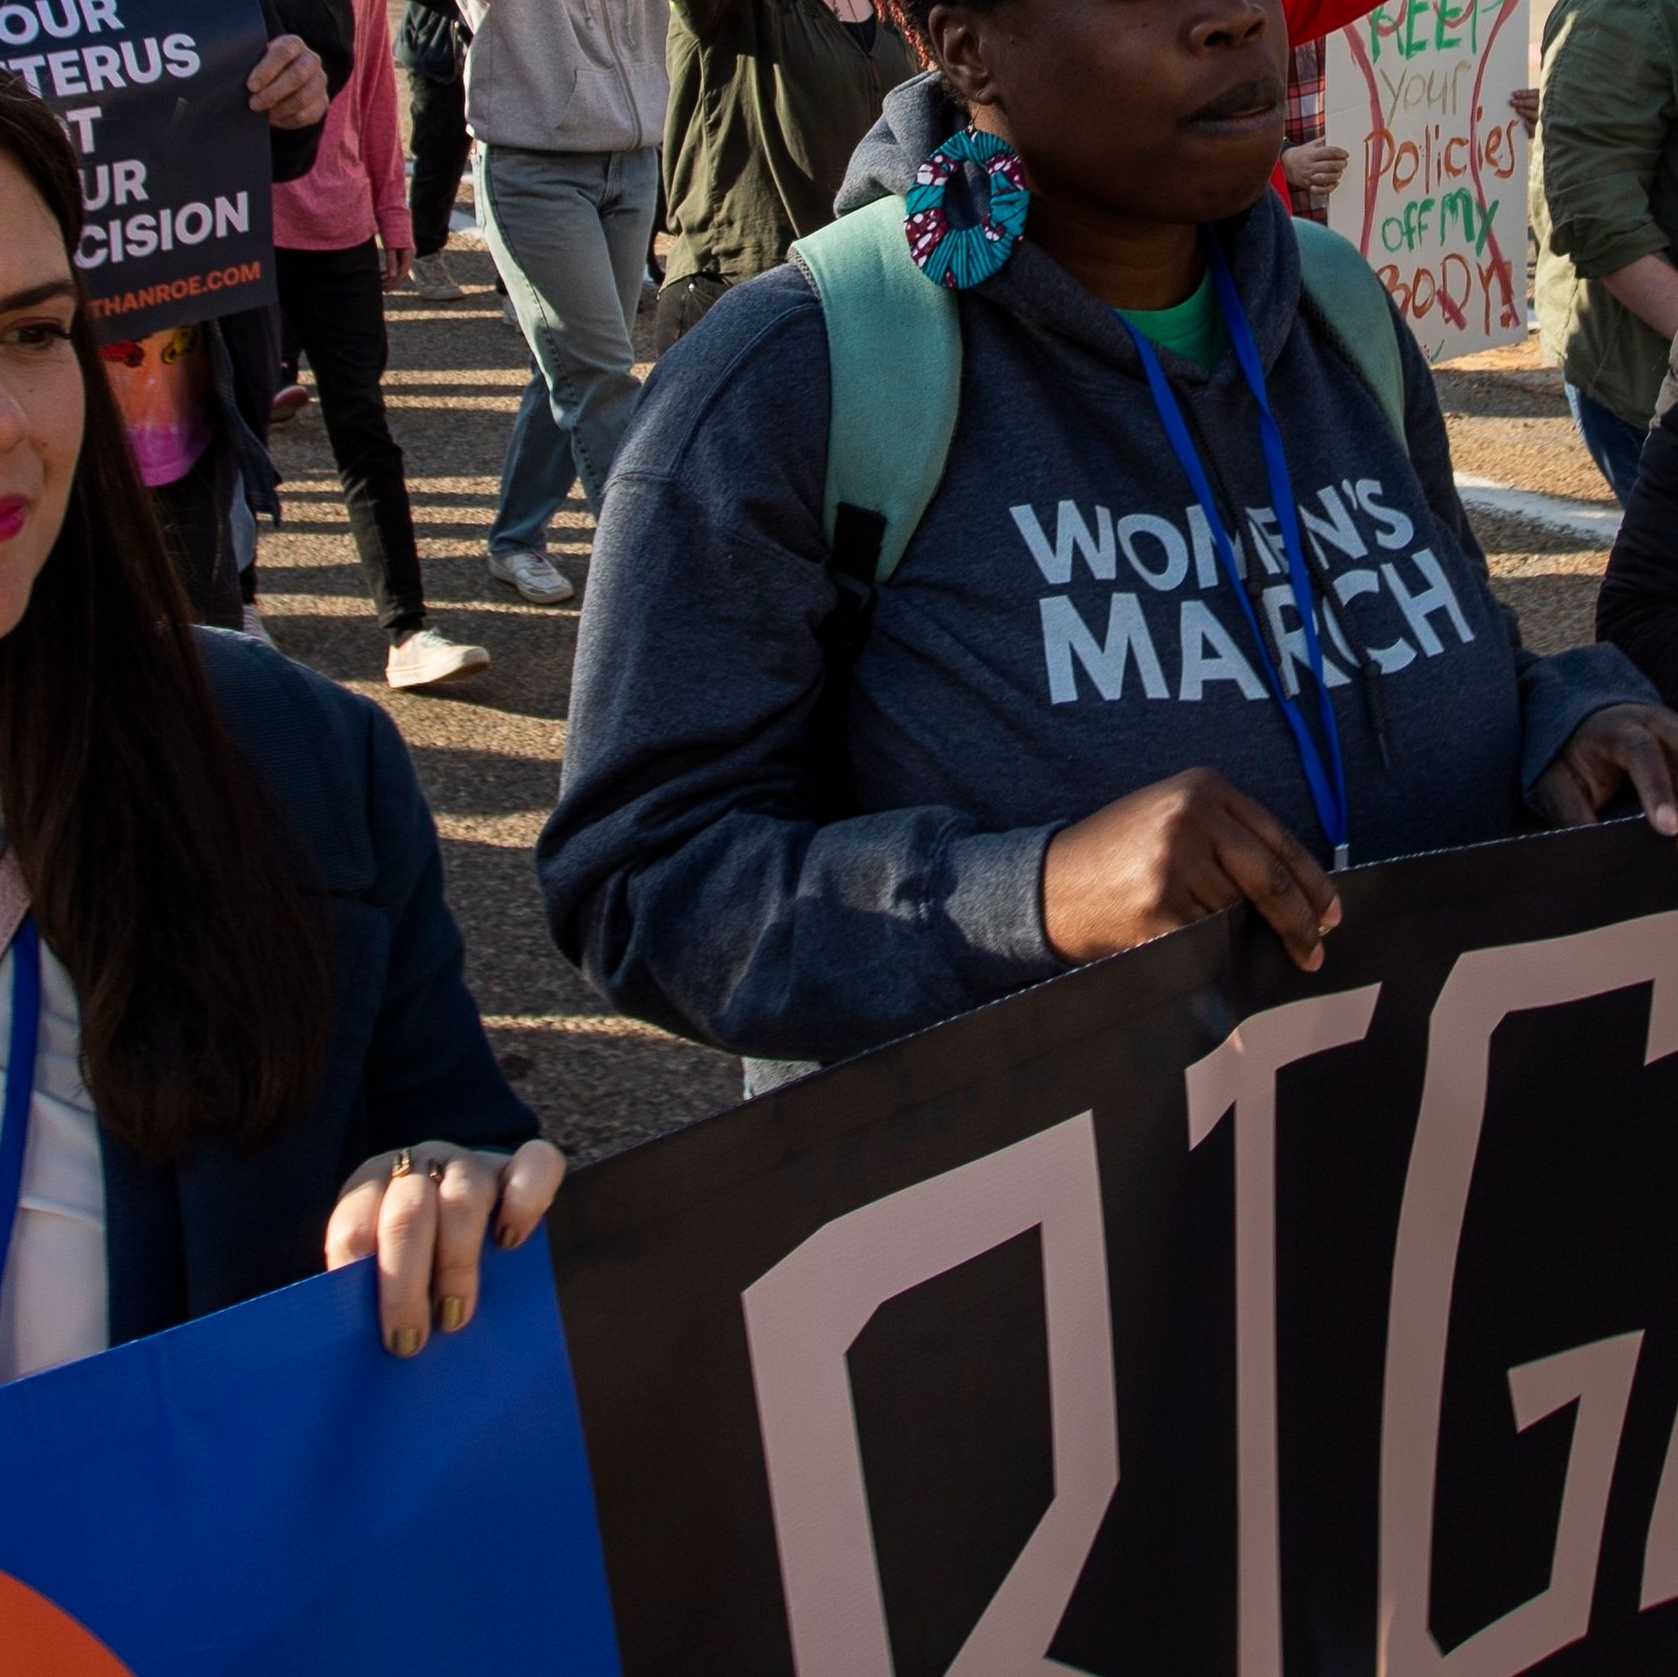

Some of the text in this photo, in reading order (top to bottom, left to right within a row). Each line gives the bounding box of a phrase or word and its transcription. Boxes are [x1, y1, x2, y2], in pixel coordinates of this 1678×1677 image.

[1379, 59, 1472, 126] your
[79, 159, 149, 212] UR
[72, 191, 250, 270] CISION
[1038, 548, 1475, 705] MARCH
